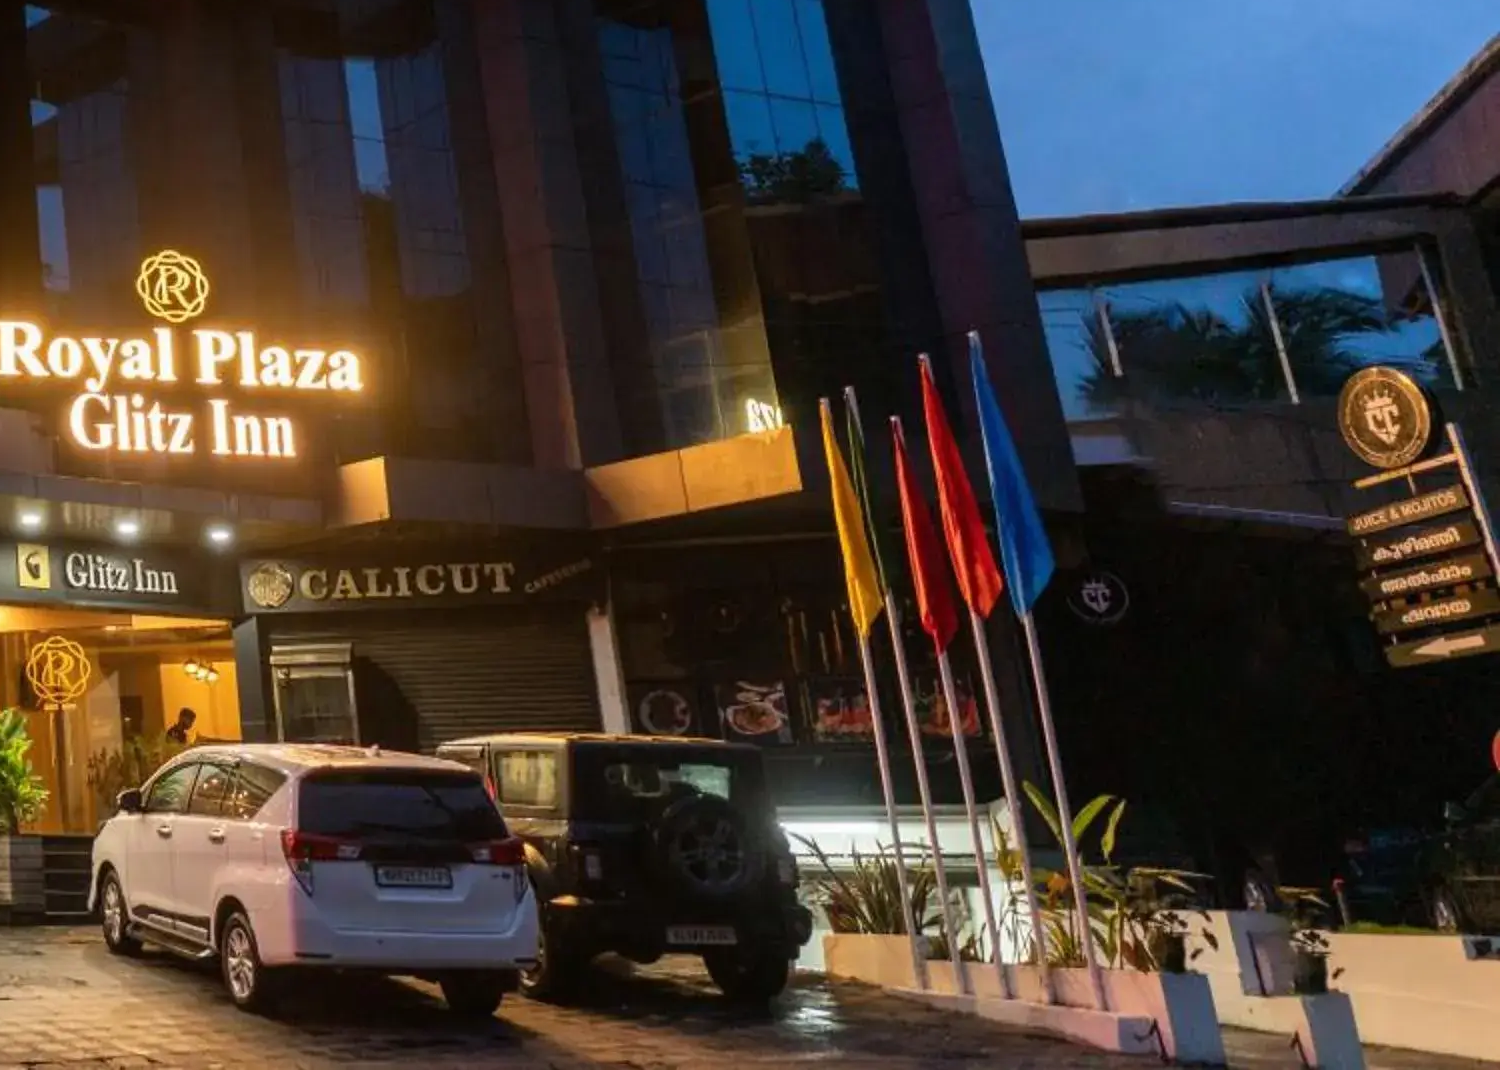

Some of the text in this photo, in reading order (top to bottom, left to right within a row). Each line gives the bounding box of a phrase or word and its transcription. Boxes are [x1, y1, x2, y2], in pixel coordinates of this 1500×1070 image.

[193, 328, 364, 392] Plaza
[69, 392, 297, 458] Glitz Inn
[1352, 513, 1389, 531] JUICE
[1400, 491, 1457, 517] MOJITOS
[65, 552, 178, 594] Glitz Inn
[299, 561, 516, 601] CALICUT
